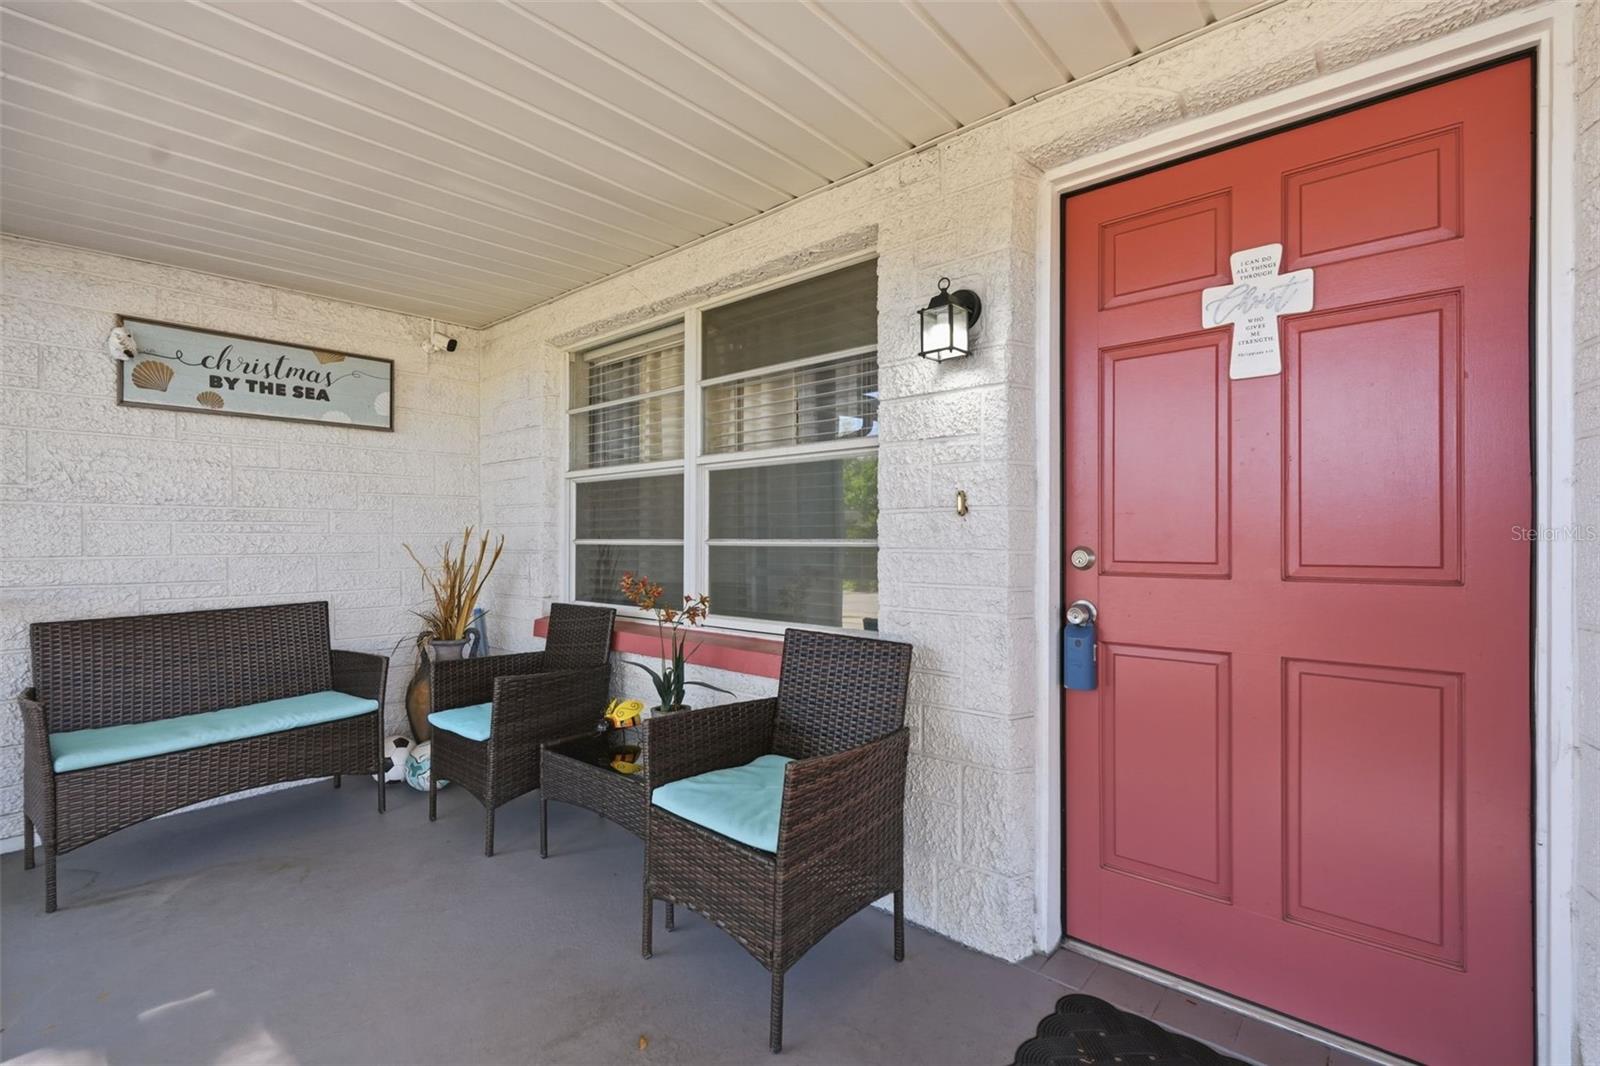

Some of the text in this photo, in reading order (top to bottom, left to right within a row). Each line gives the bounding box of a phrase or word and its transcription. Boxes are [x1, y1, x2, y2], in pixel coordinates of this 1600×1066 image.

[1244, 257, 1260, 266] CAN
[1251, 262, 1277, 271] THINGS
[1240, 270, 1273, 280] THROUGH
[1205, 275, 1309, 325] Christ
[1245, 323, 1266, 331] GIVES
[1238, 336, 1274, 346] STRENGTH
[200, 344, 332, 387] christmas
[209, 375, 331, 402] BY THE SEA
